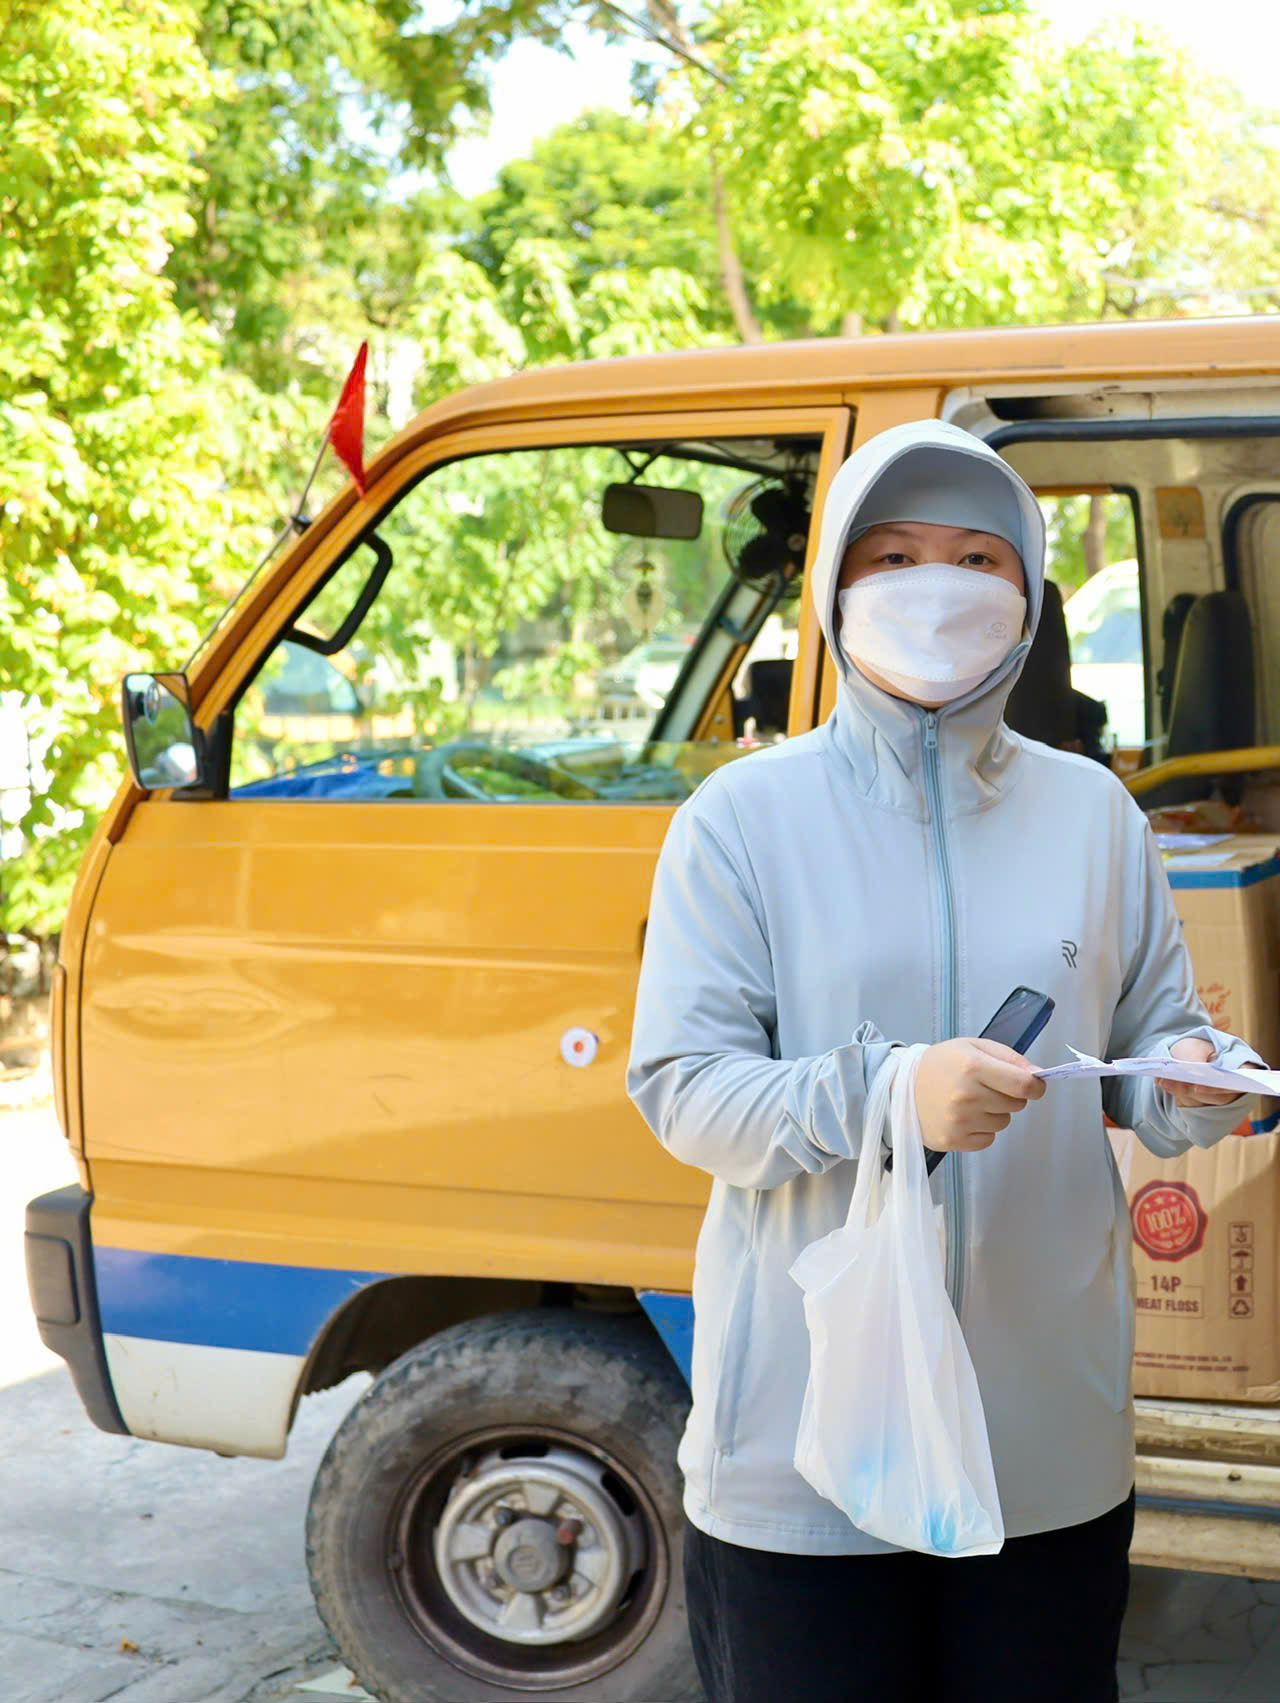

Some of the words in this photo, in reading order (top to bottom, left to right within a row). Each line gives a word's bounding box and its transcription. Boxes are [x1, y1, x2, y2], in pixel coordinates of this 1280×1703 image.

[1145, 1203, 1187, 1233] 100%
[1151, 1275, 1182, 1293] 14P
[1165, 1299, 1200, 1312] FLOSS
